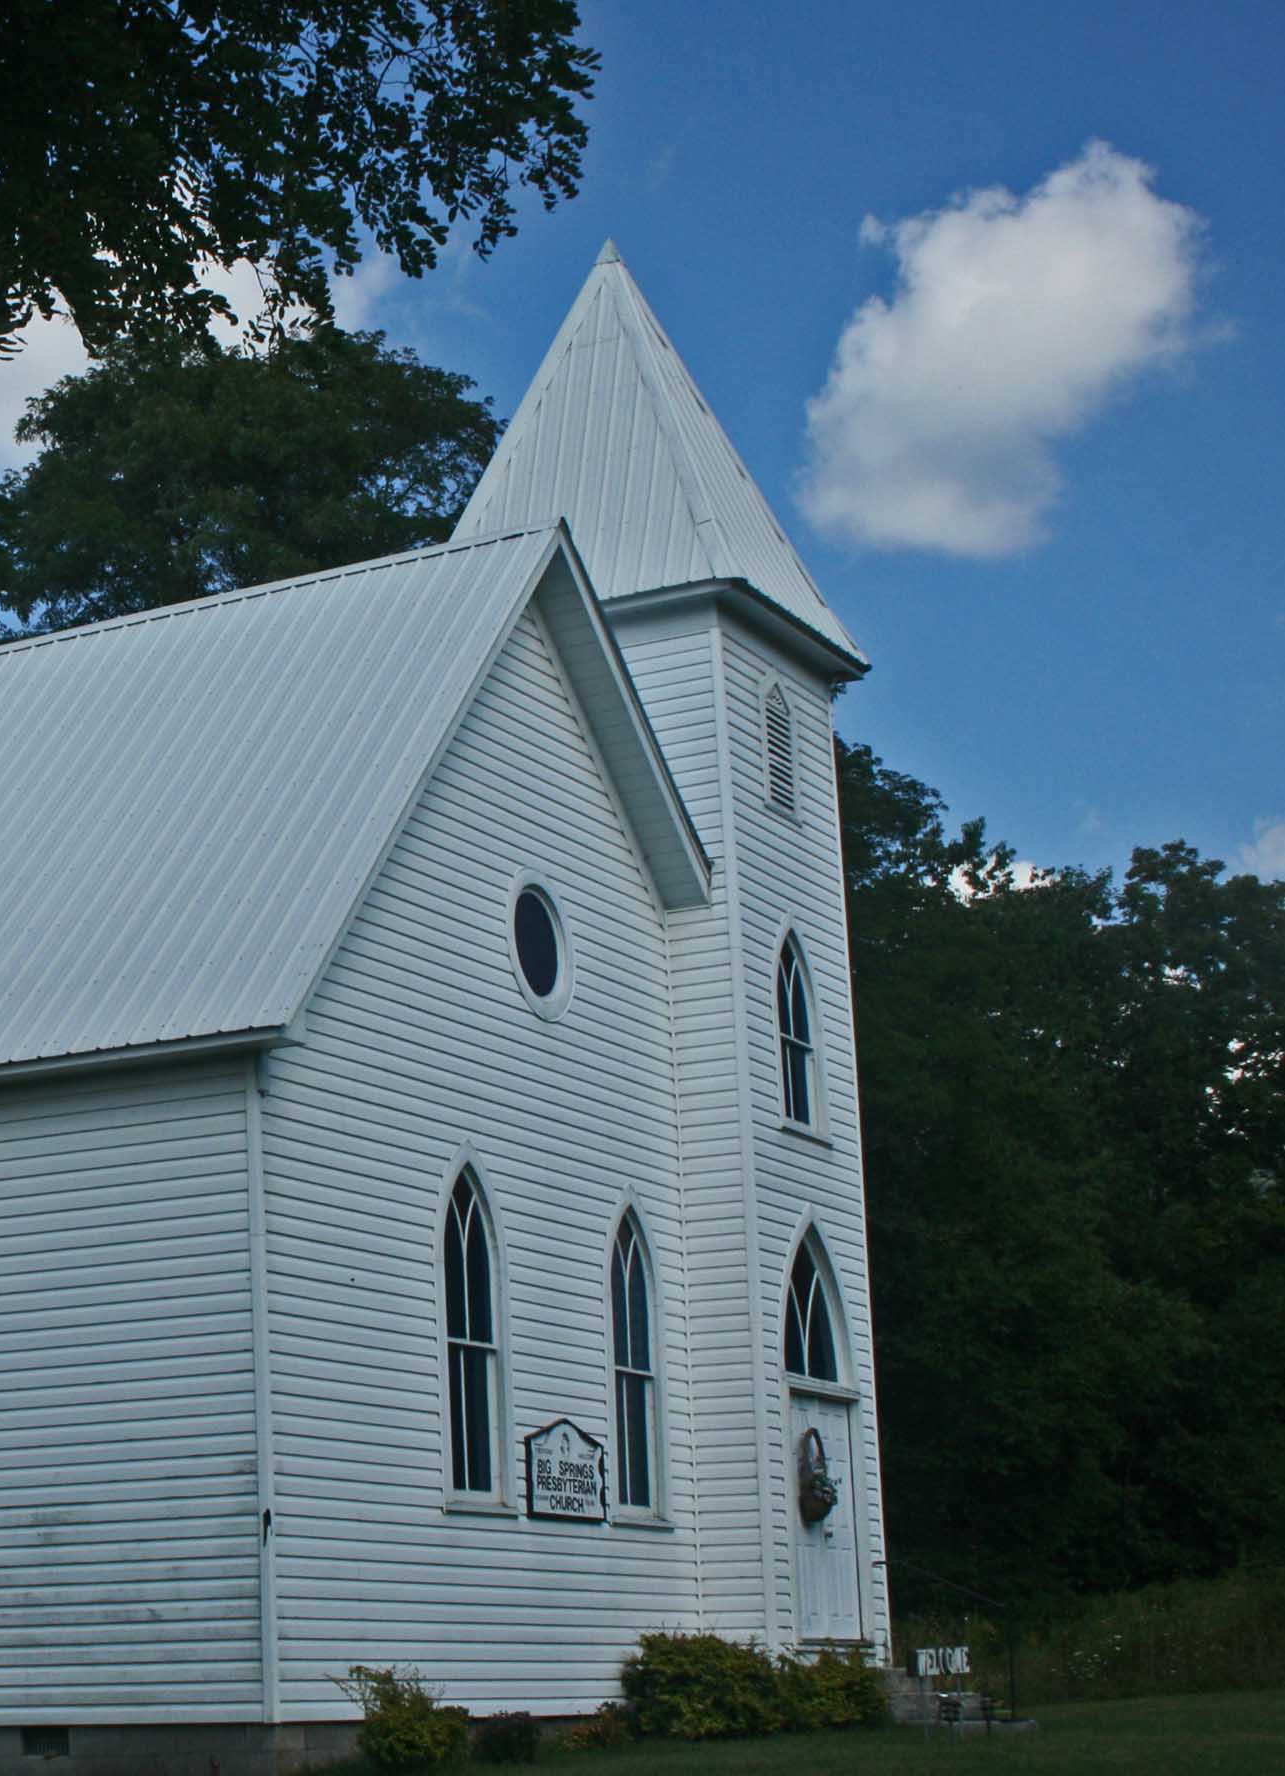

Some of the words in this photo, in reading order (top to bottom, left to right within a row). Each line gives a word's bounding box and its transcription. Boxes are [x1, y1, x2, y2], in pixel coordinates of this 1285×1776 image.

[537, 1459, 552, 1474] BIG
[559, 1460, 595, 1480] SPRINGS
[537, 1475, 597, 1497] PRESBYTERIAN
[549, 1494, 585, 1513] CHURCH
[916, 1646, 971, 1676] WELCOME
